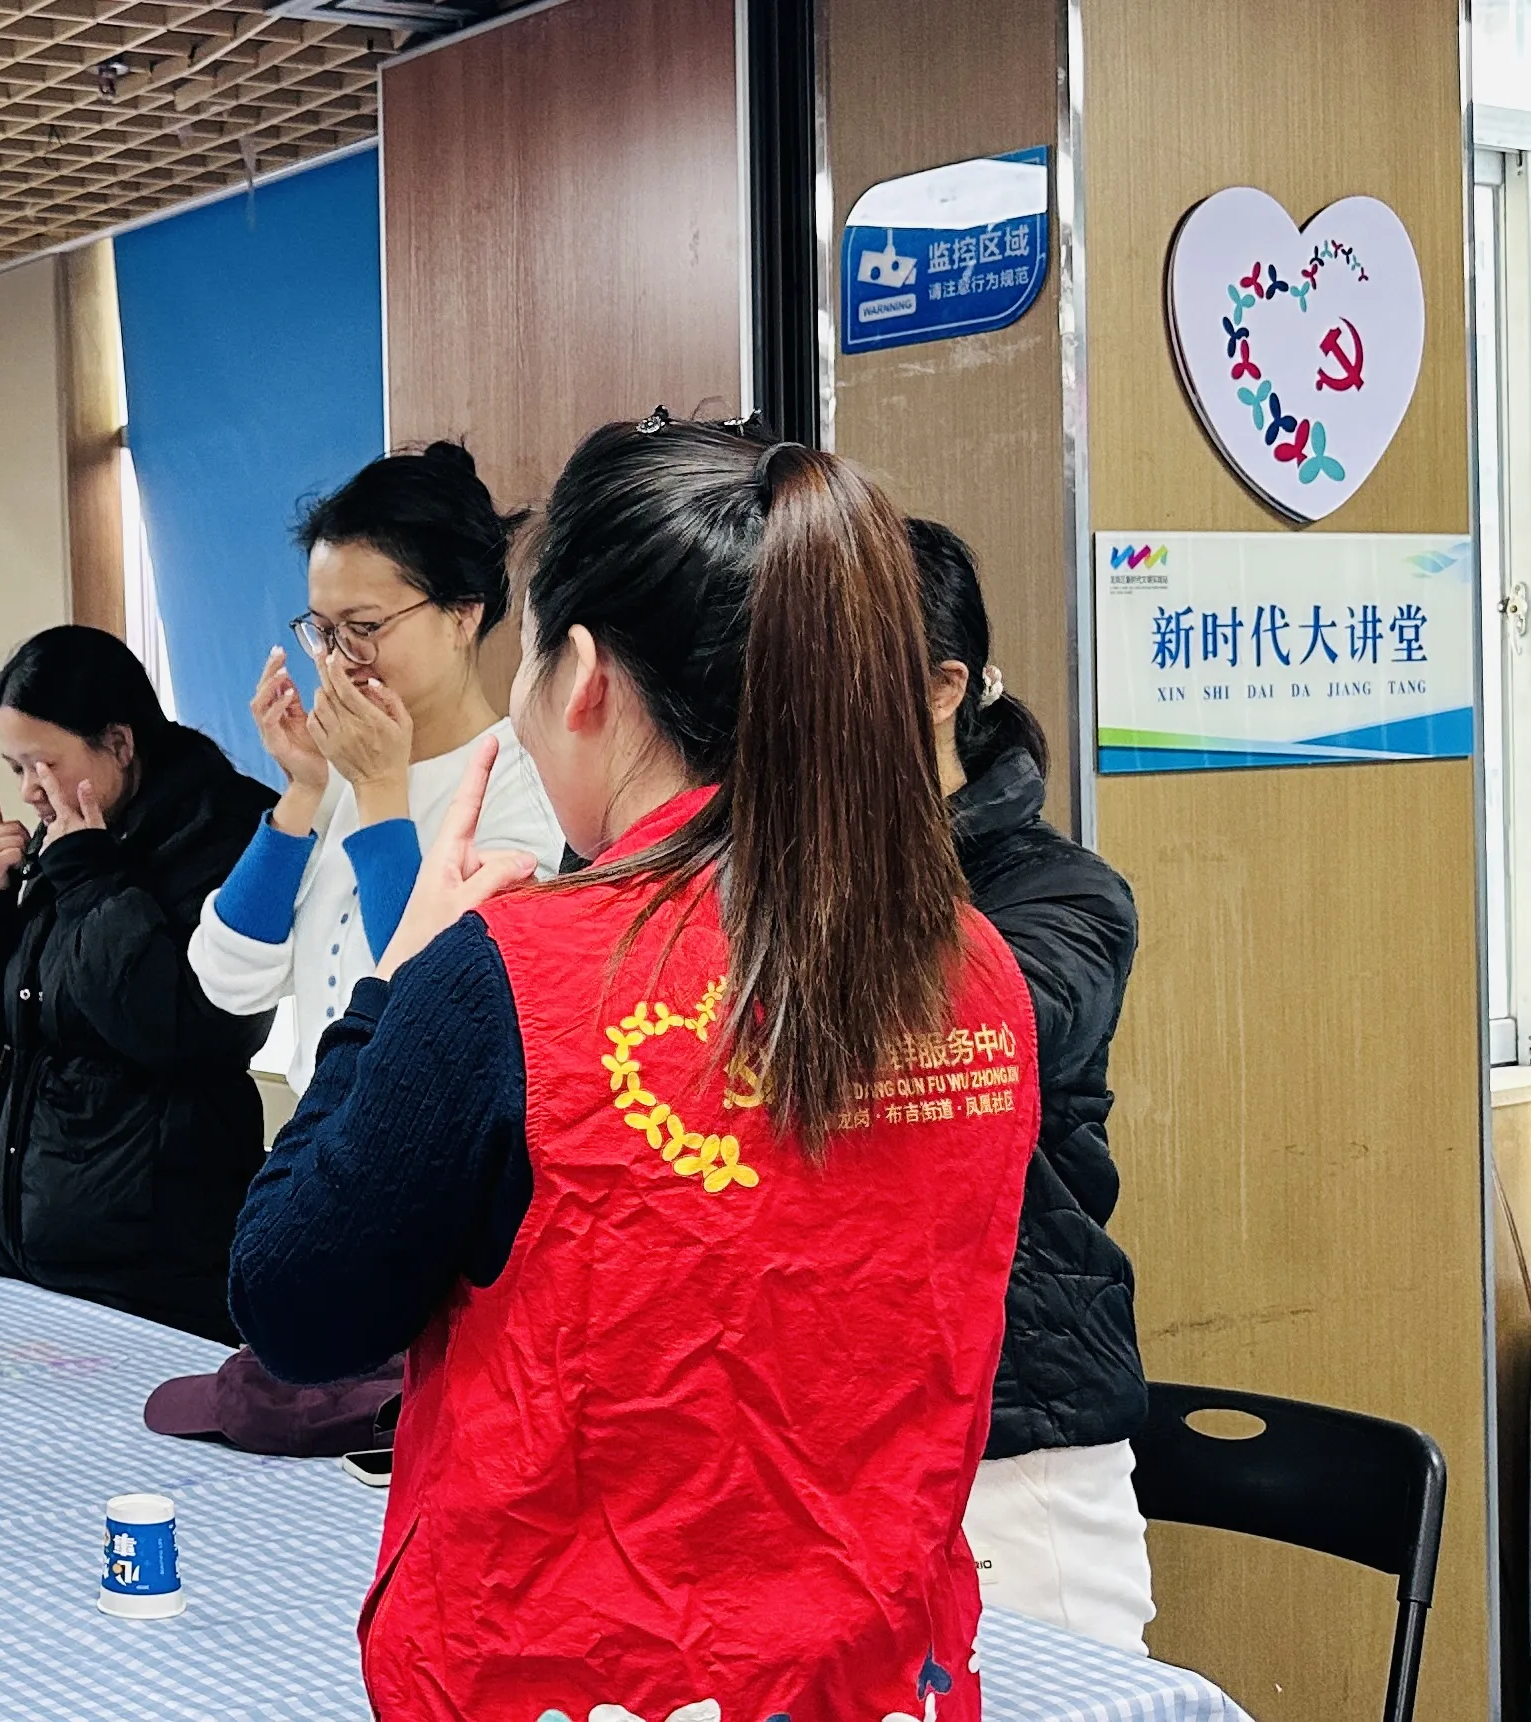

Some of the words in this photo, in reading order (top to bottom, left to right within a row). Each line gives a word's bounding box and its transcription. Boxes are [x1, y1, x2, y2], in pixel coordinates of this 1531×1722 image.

[927, 224, 1030, 274] 监控区域
[928, 266, 1030, 300] 请注意行为规范
[1151, 604, 1428, 670] 新时代大讲堂
[1157, 686, 1186, 702] XIN
[1203, 685, 1230, 700] SHI
[1247, 684, 1274, 699] DAI
[1291, 683, 1311, 698] DA
[1327, 681, 1372, 698] JIANG
[1388, 679, 1427, 695] TANG
[897, 1075, 925, 1098] QUN
[927, 1074, 946, 1093] FU
[946, 1071, 970, 1092] WU
